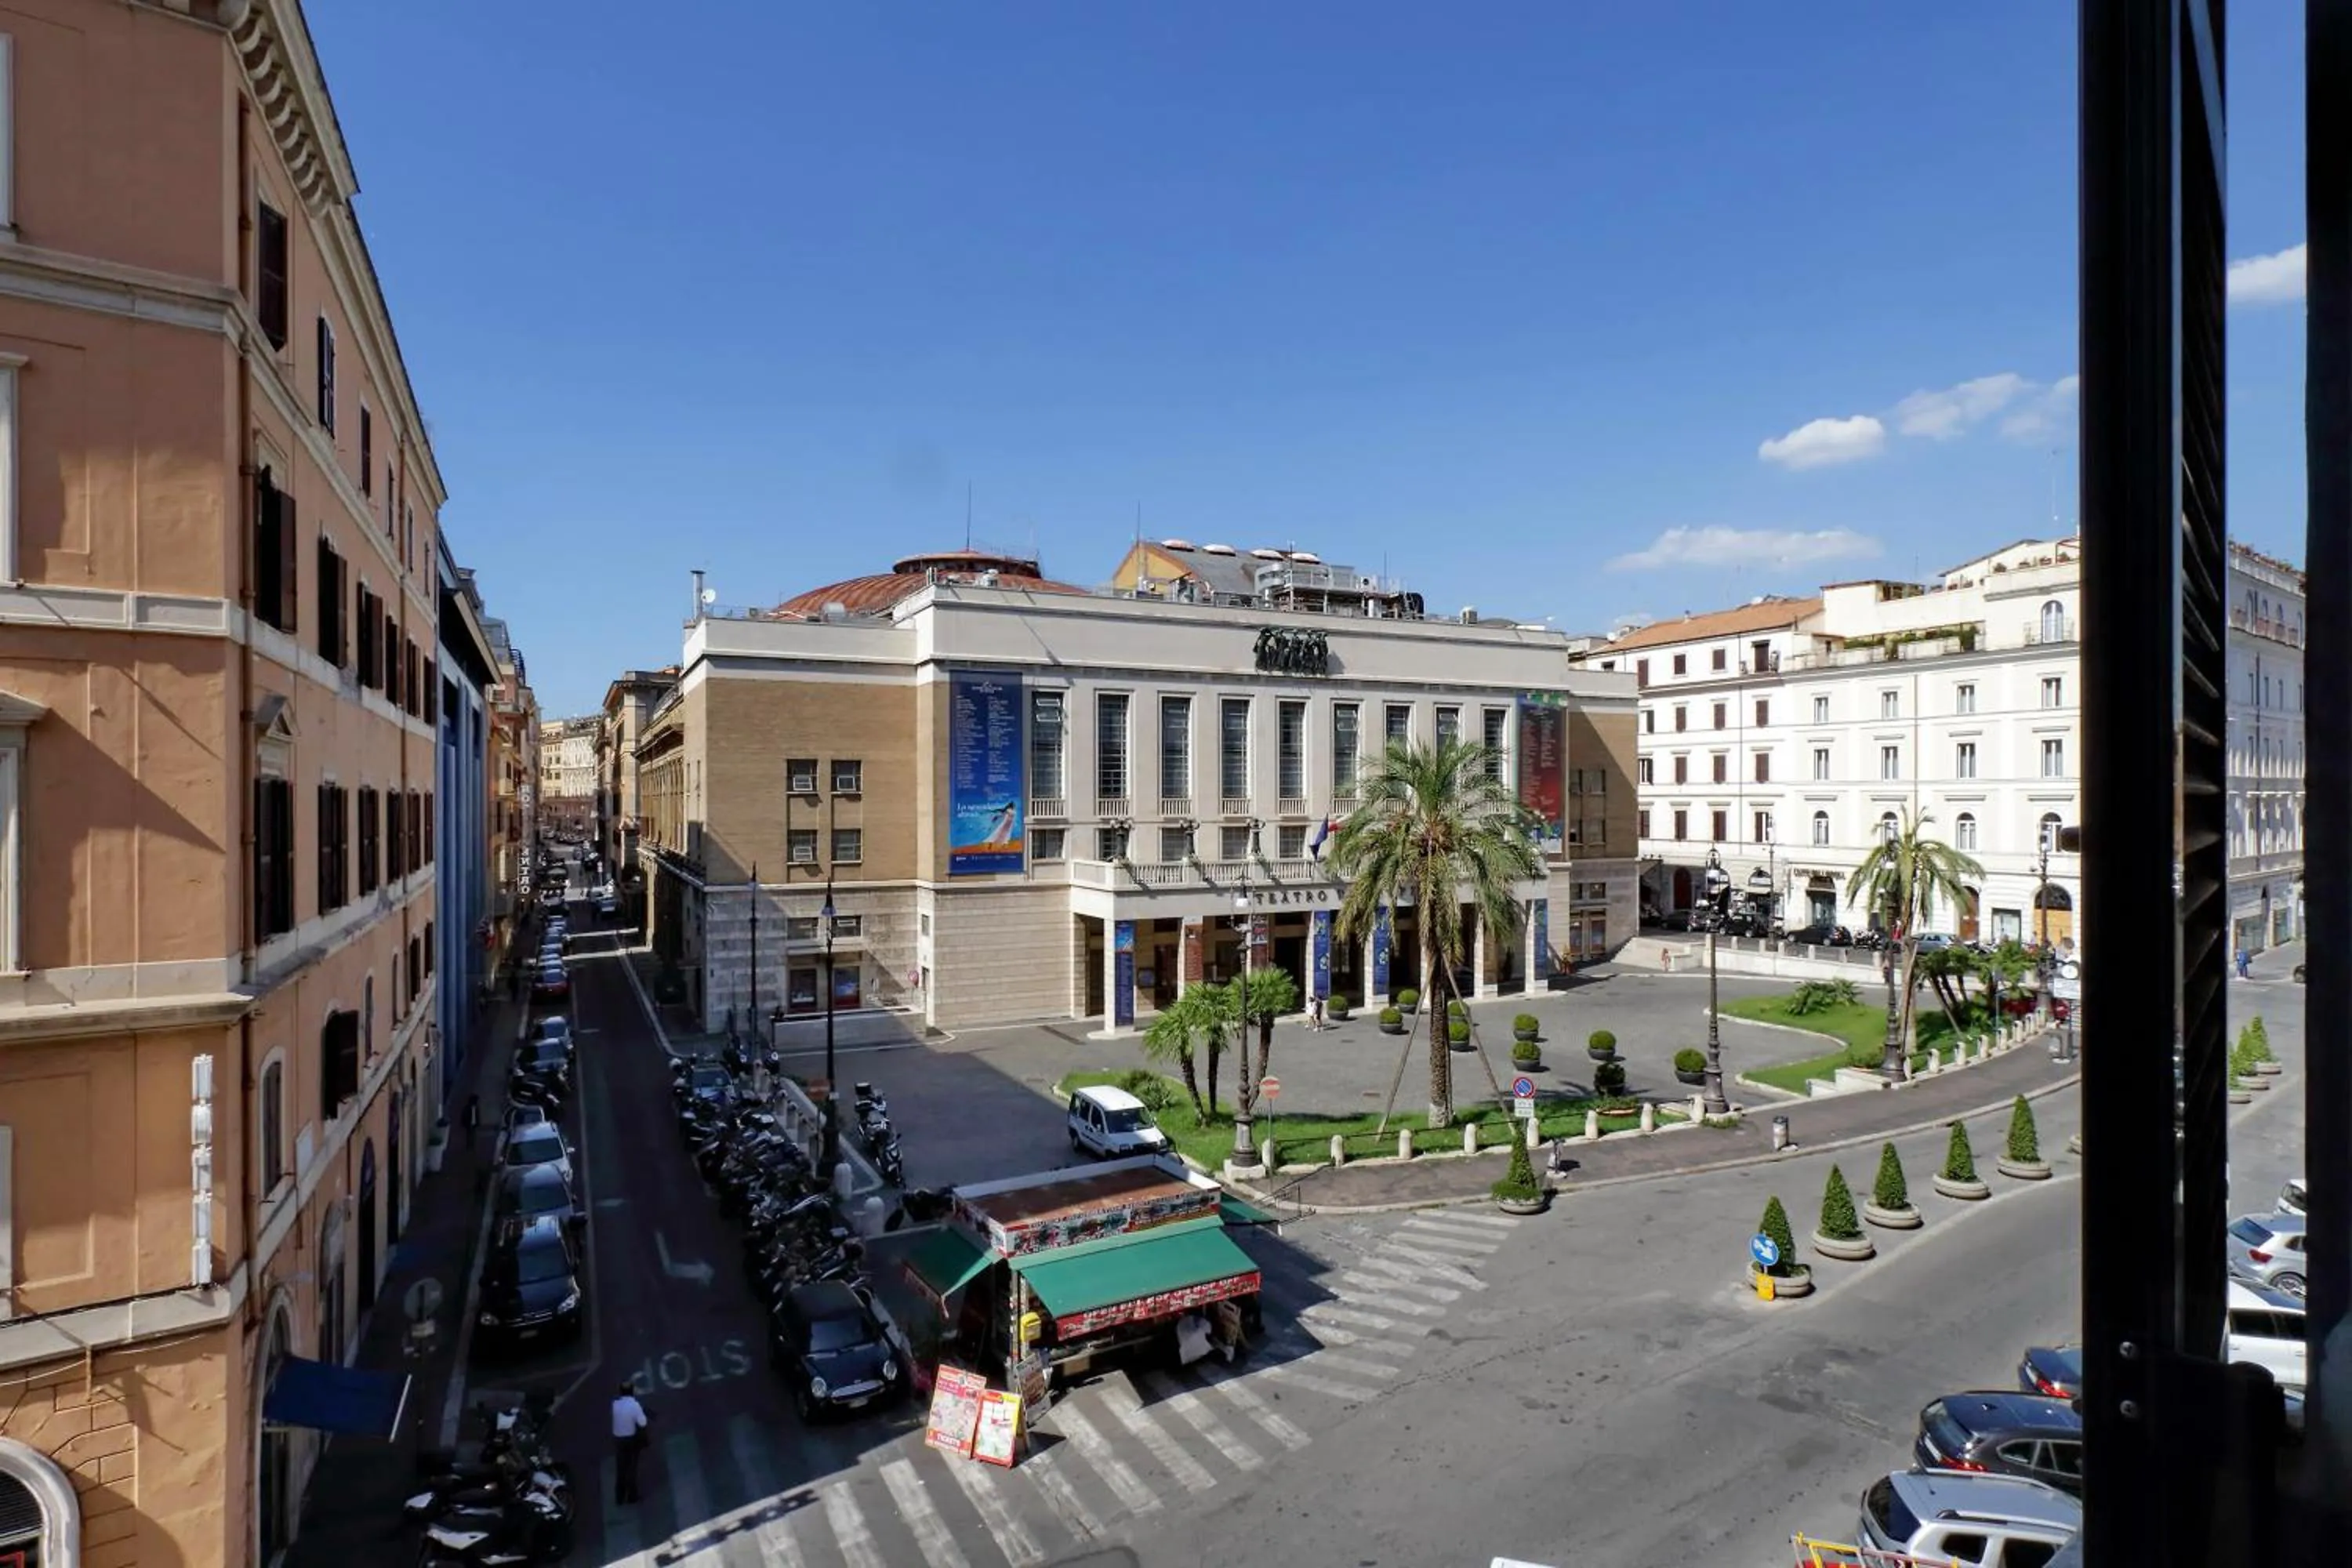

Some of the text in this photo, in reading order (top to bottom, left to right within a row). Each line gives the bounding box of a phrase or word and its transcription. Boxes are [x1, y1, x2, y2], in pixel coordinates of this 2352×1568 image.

[1254, 890, 1328, 906] TEATRO
[1193, 1282, 1216, 1292] HOP
[1219, 1276, 1240, 1286] OFF
[630, 1339, 752, 1396] STOP
